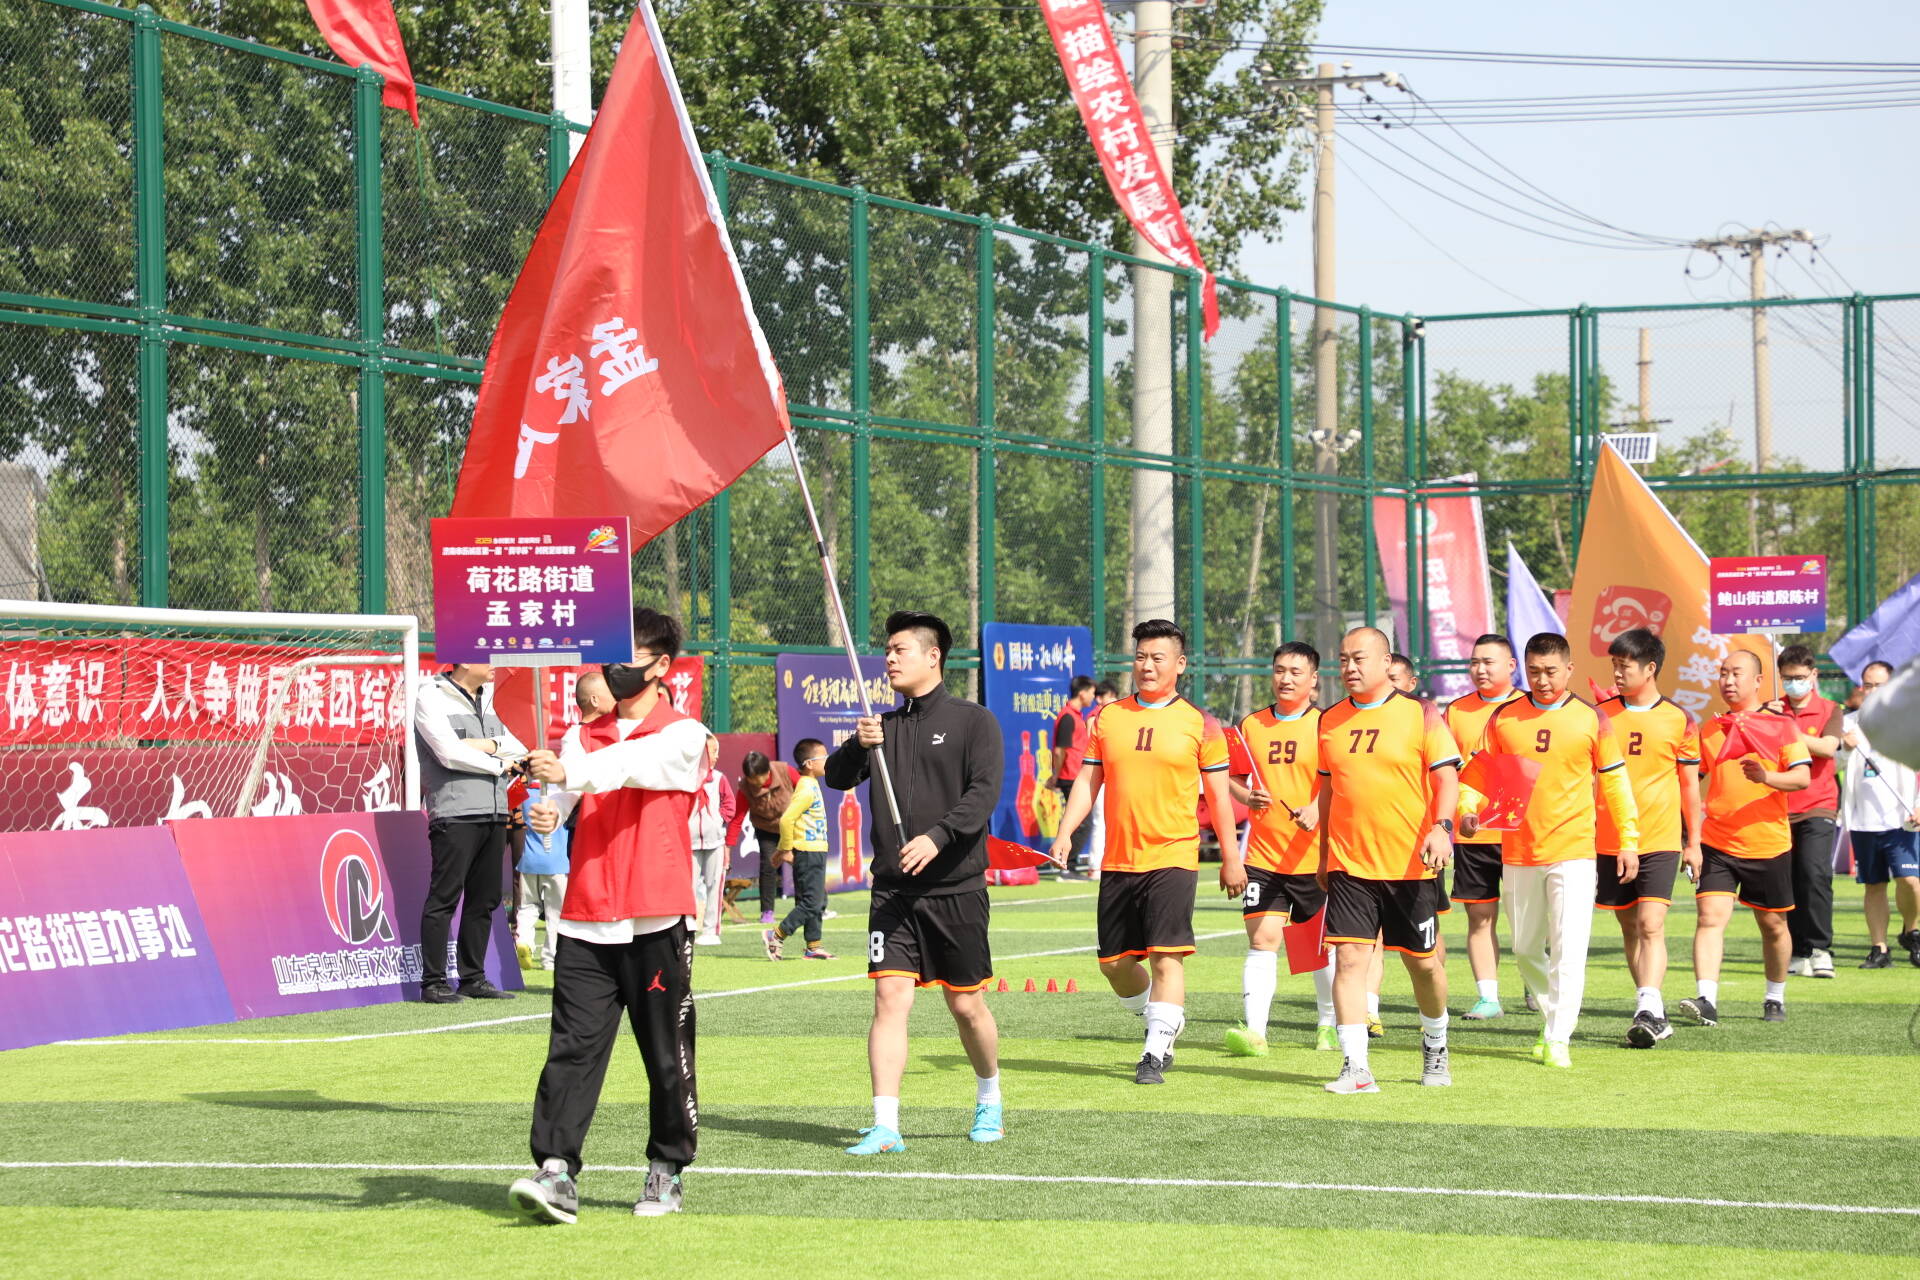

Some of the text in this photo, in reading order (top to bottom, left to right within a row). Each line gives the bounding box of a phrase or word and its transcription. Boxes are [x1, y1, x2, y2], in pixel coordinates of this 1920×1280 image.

[466, 565, 595, 593] 荷花路街道
[486, 599, 577, 627] 孟家村
[5, 659, 105, 730] 体意识
[1135, 727, 1153, 751] 11
[1349, 729, 1379, 753] 77
[1535, 729, 1551, 753] 9
[1629, 732, 1643, 755] 2
[1268, 740, 1297, 764] 29
